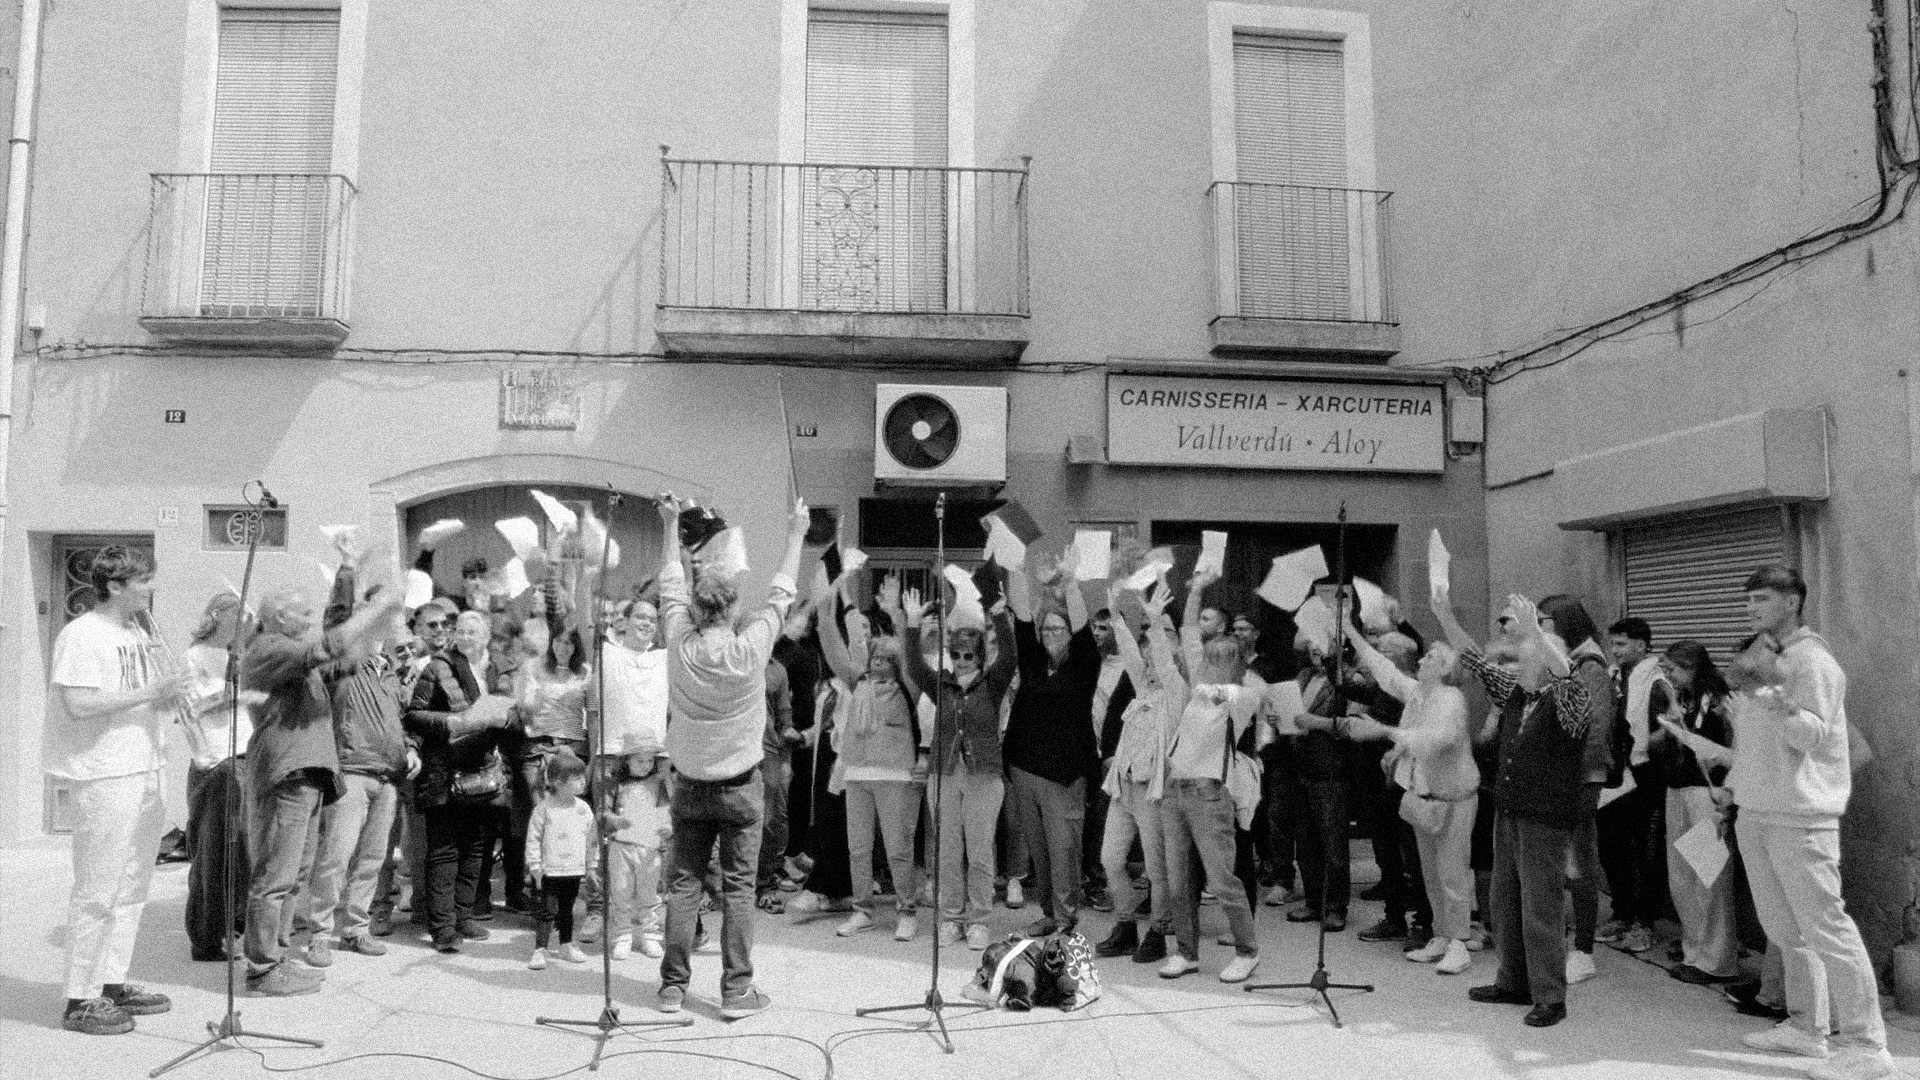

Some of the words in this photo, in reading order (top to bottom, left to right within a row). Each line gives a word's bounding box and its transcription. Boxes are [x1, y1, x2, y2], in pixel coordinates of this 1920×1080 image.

[168, 410, 182, 422] 12
[1120, 388, 1268, 410] CARNISSERIA
[1296, 395, 1433, 416] XARCUTERIA
[1177, 424, 1292, 452] Vallverdú
[1322, 429, 1383, 464] Aloy
